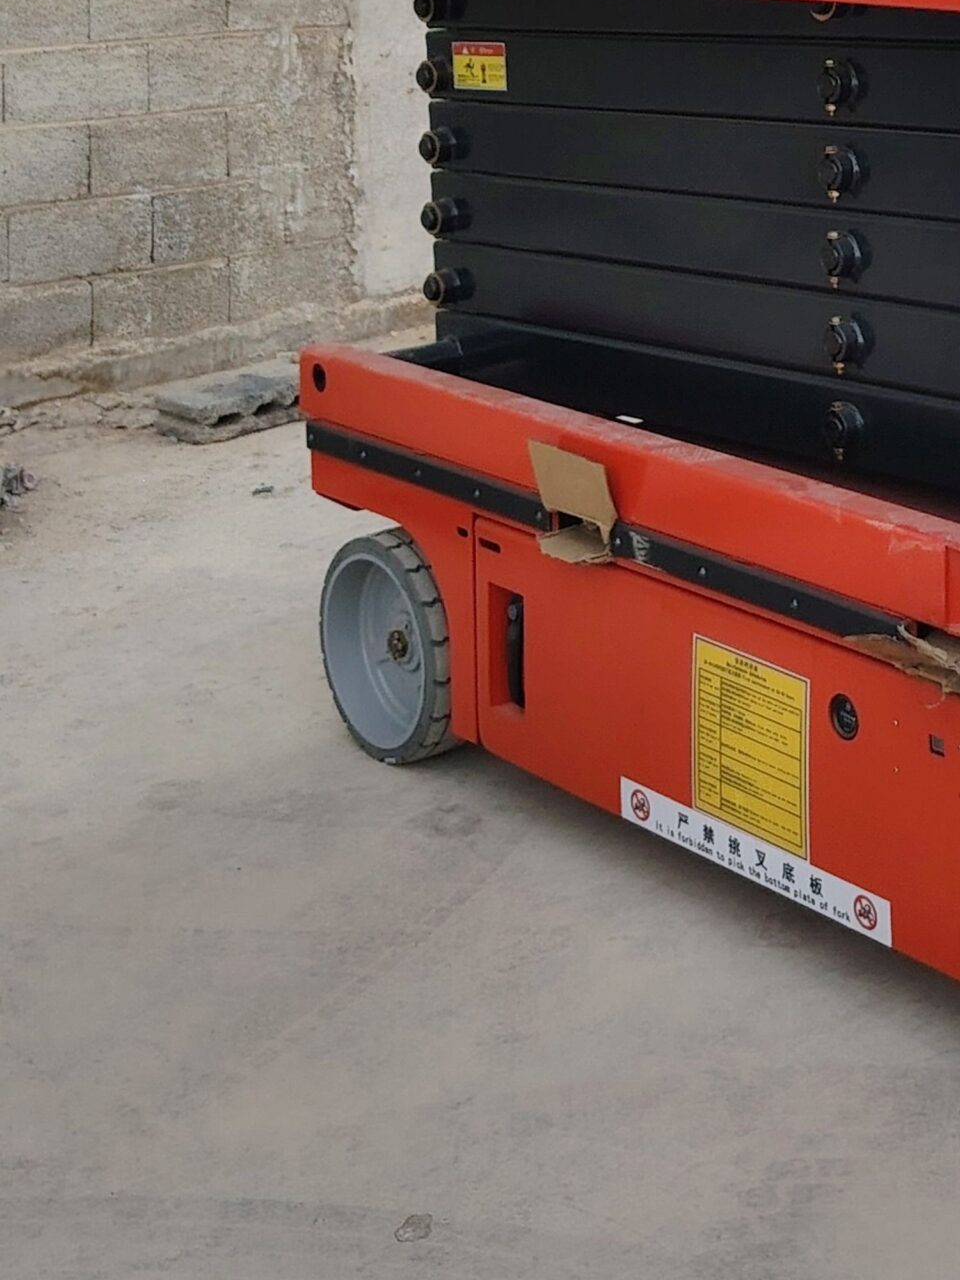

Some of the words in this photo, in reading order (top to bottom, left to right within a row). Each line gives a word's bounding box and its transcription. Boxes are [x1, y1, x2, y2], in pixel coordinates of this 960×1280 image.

[678, 830, 713, 855] forbidden
[716, 850, 725, 862] to
[728, 856, 745, 871] pick
[748, 865, 761, 879] the
[764, 871, 791, 893] bottom
[793, 888, 816, 906] plate
[819, 900, 828, 912] of
[832, 905, 851, 922] fork
